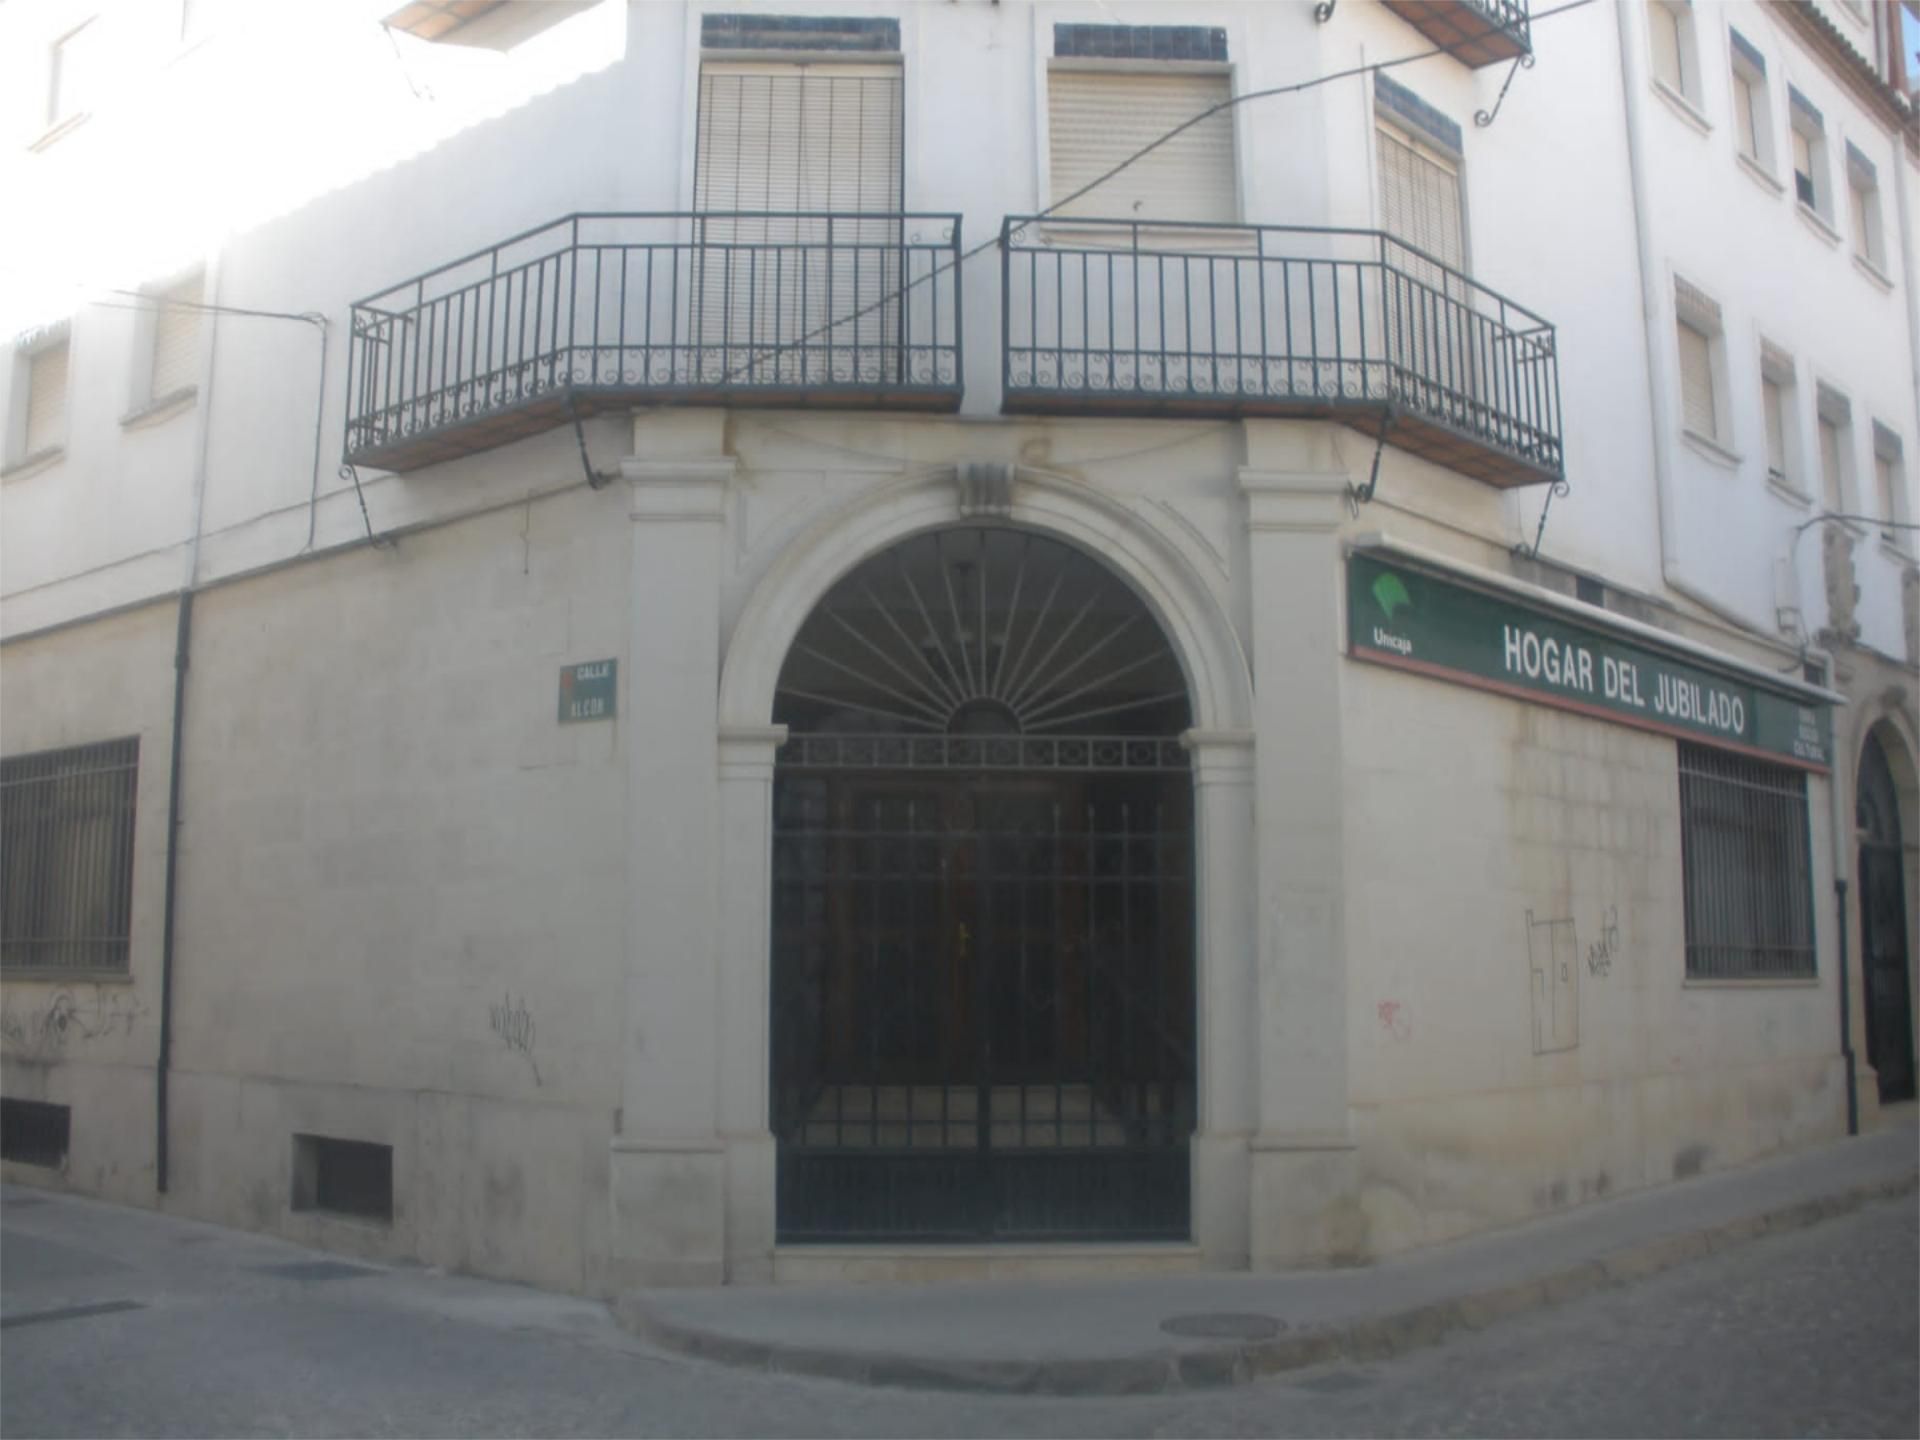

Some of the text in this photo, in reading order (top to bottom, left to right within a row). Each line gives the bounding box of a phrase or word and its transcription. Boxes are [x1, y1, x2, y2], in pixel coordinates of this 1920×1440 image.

[1373, 626, 1412, 655] Unicaja
[576, 663, 609, 680] CALLE
[1504, 625, 1744, 734] HOGAR DEL JUBILADO
